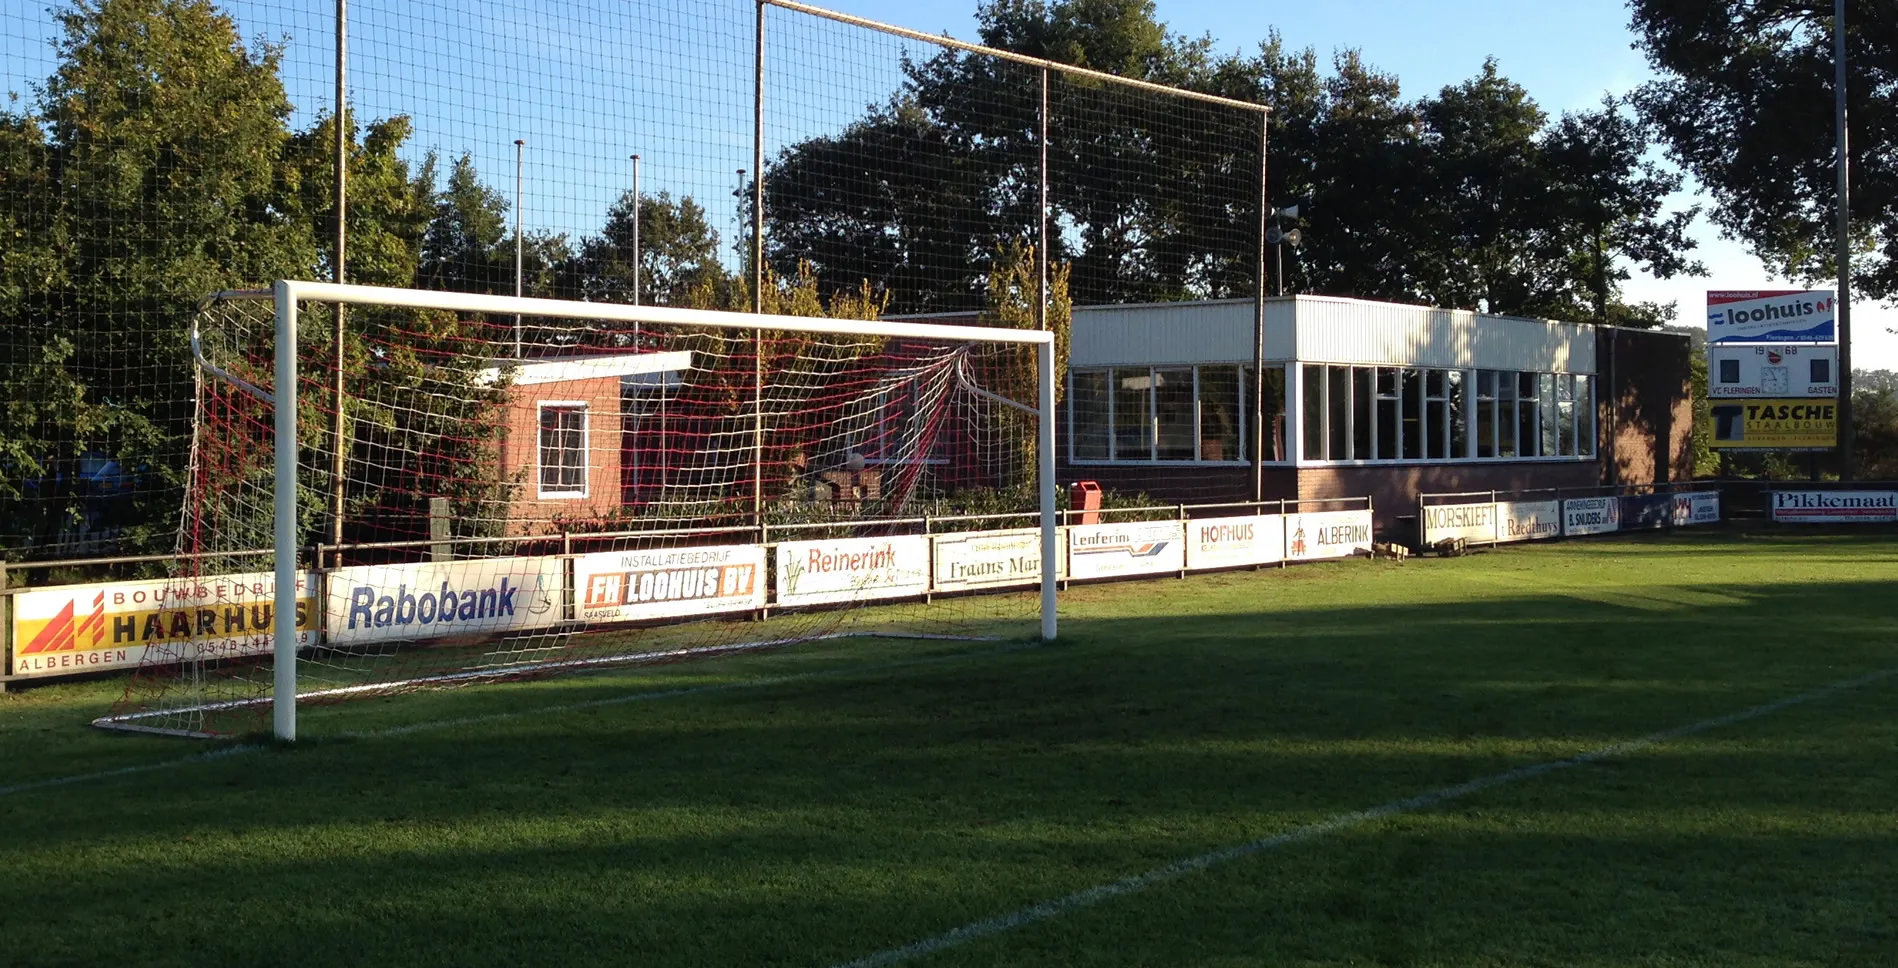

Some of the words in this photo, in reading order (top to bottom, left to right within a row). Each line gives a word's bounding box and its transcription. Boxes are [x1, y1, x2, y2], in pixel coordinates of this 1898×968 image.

[1727, 299, 1814, 325] loohuis
[1755, 346, 1765, 355] 19
[1785, 346, 1798, 355] 68
[1712, 387, 1722, 395] VC
[1723, 386, 1761, 395] FLERINGEN
[1808, 386, 1837, 394] GASTEN
[1747, 405, 1834, 420] TASCHE
[1746, 421, 1835, 429] STAALBOUW
[1777, 492, 1895, 508] Pikkemaat
[1426, 505, 1494, 530] MORSKIEFT
[1201, 523, 1255, 544] HOFHUIS
[1317, 524, 1369, 546] ALBERINK
[621, 550, 732, 568] INSTALLATIEBEDRIJF
[808, 543, 896, 574] Reinerink
[114, 580, 304, 605] BOUWBEDRIF
[591, 574, 620, 605] FH
[627, 568, 719, 603] LOOHUIS
[723, 565, 753, 596] BV
[348, 577, 517, 630] Rabobank
[114, 602, 306, 643] HAARHUS
[19, 650, 127, 671] ALBERGEN
